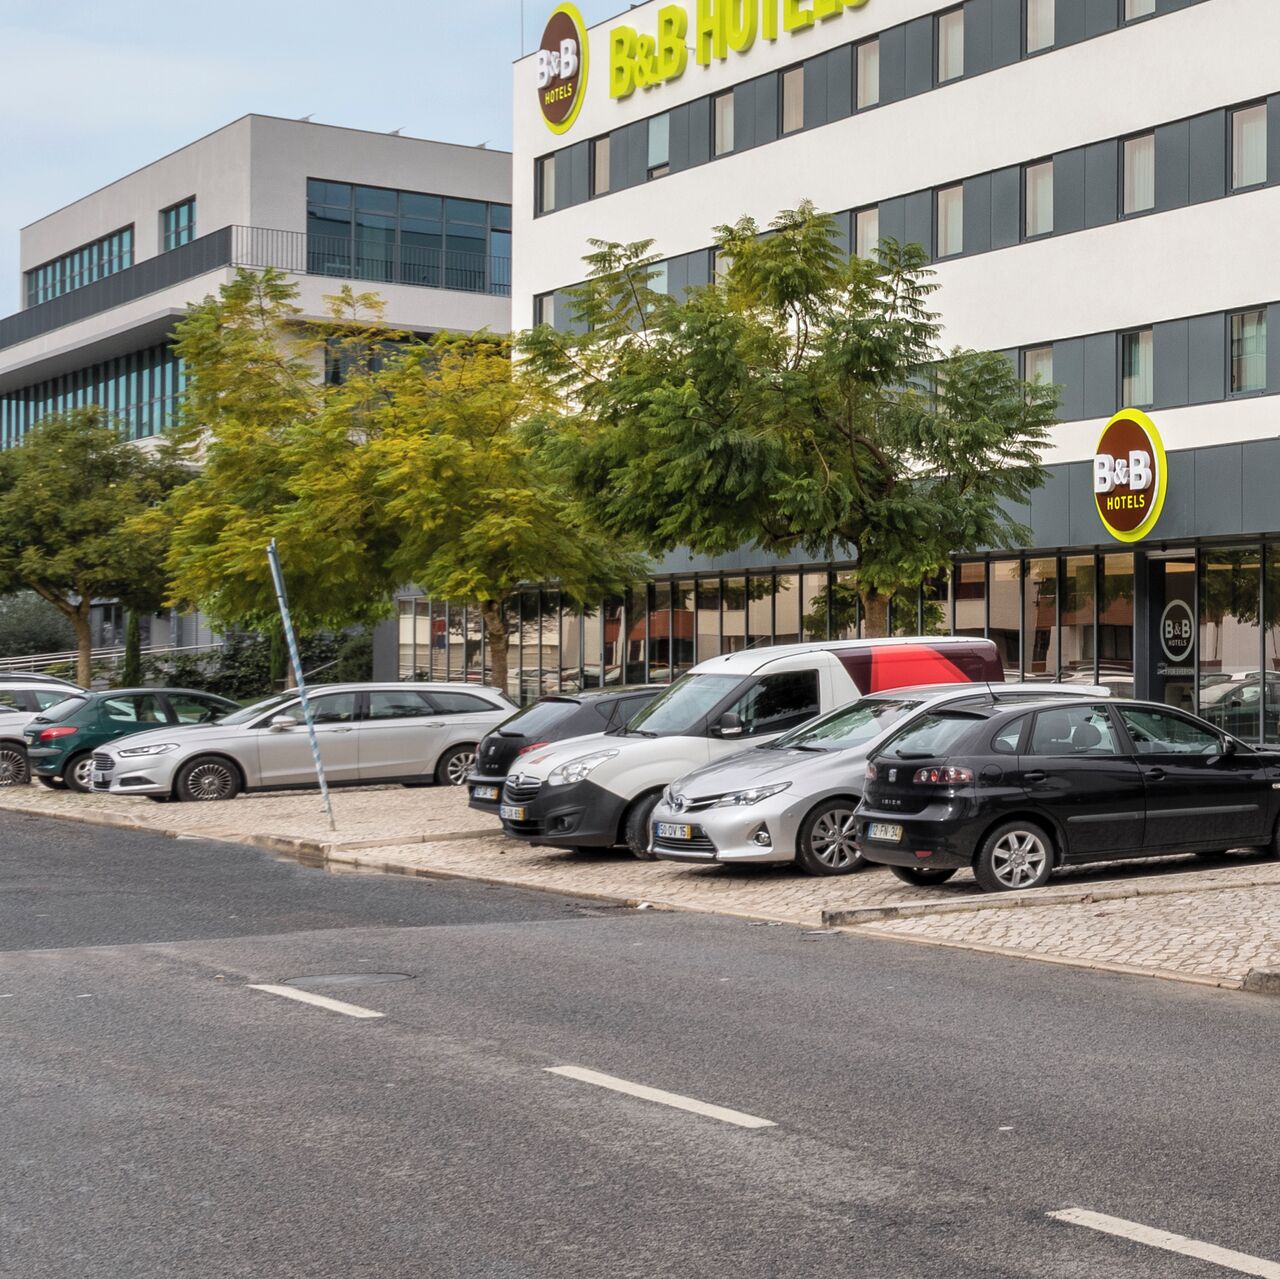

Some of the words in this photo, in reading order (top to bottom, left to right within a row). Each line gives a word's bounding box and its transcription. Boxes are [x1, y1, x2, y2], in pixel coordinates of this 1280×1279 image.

[536, 38, 578, 89] B&B
[610, 4, 688, 99] B&B
[544, 83, 573, 105] HOTELS
[1094, 450, 1152, 492] B&B
[1107, 494, 1145, 511] HOTELS
[1165, 619, 1191, 638] B&B
